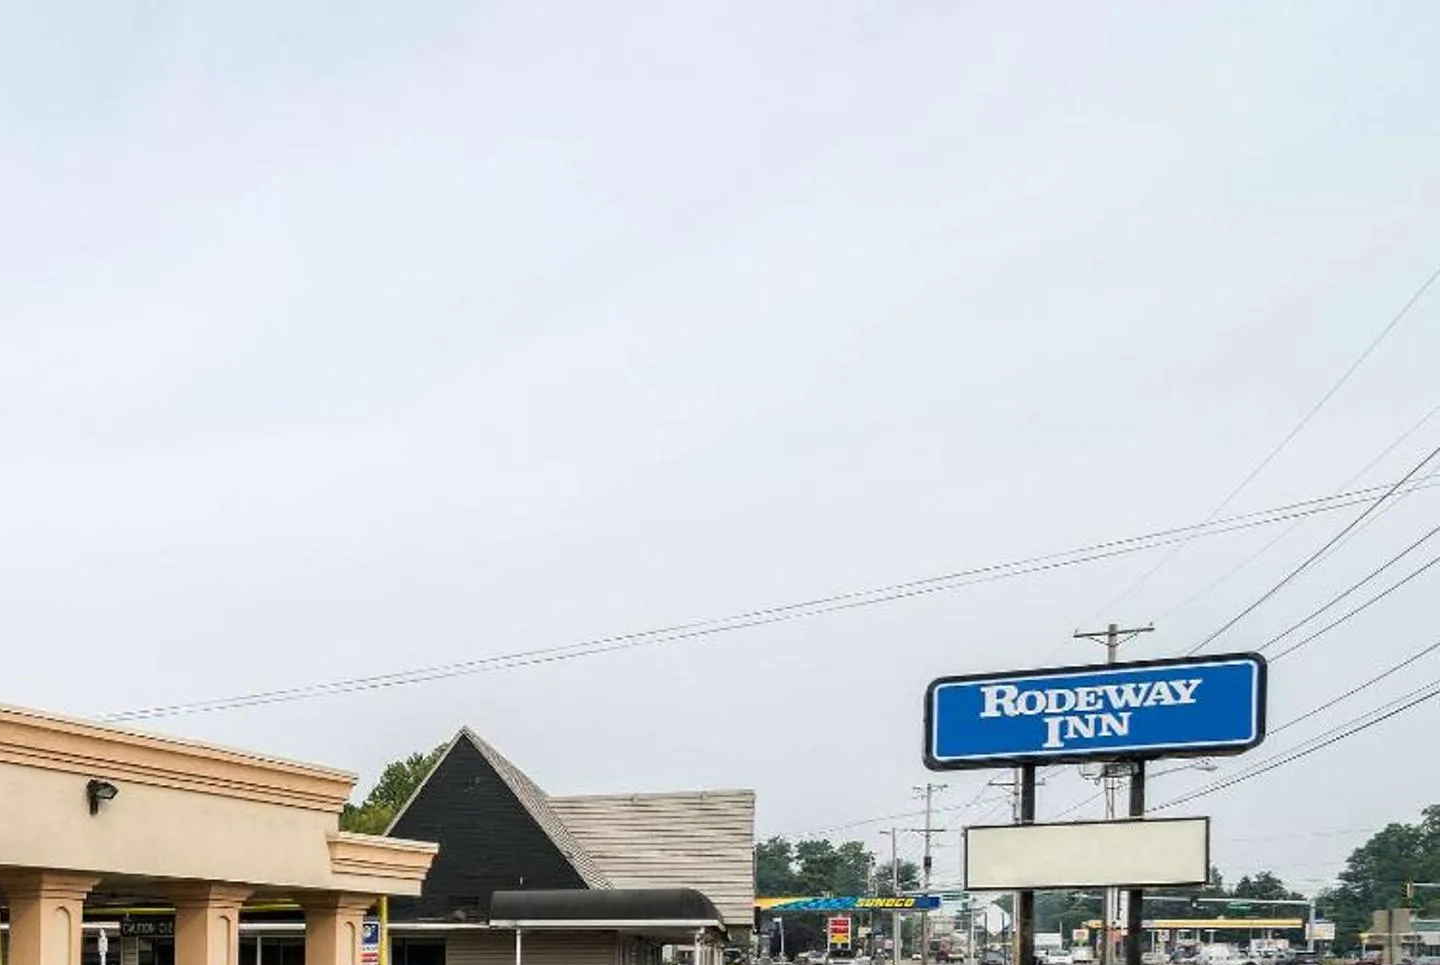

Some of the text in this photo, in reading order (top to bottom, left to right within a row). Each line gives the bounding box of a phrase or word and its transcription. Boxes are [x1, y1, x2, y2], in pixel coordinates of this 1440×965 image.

[980, 678, 1202, 718] RODEWAY
[1043, 711, 1131, 748] INN
[855, 897, 916, 908] SUNOCO
